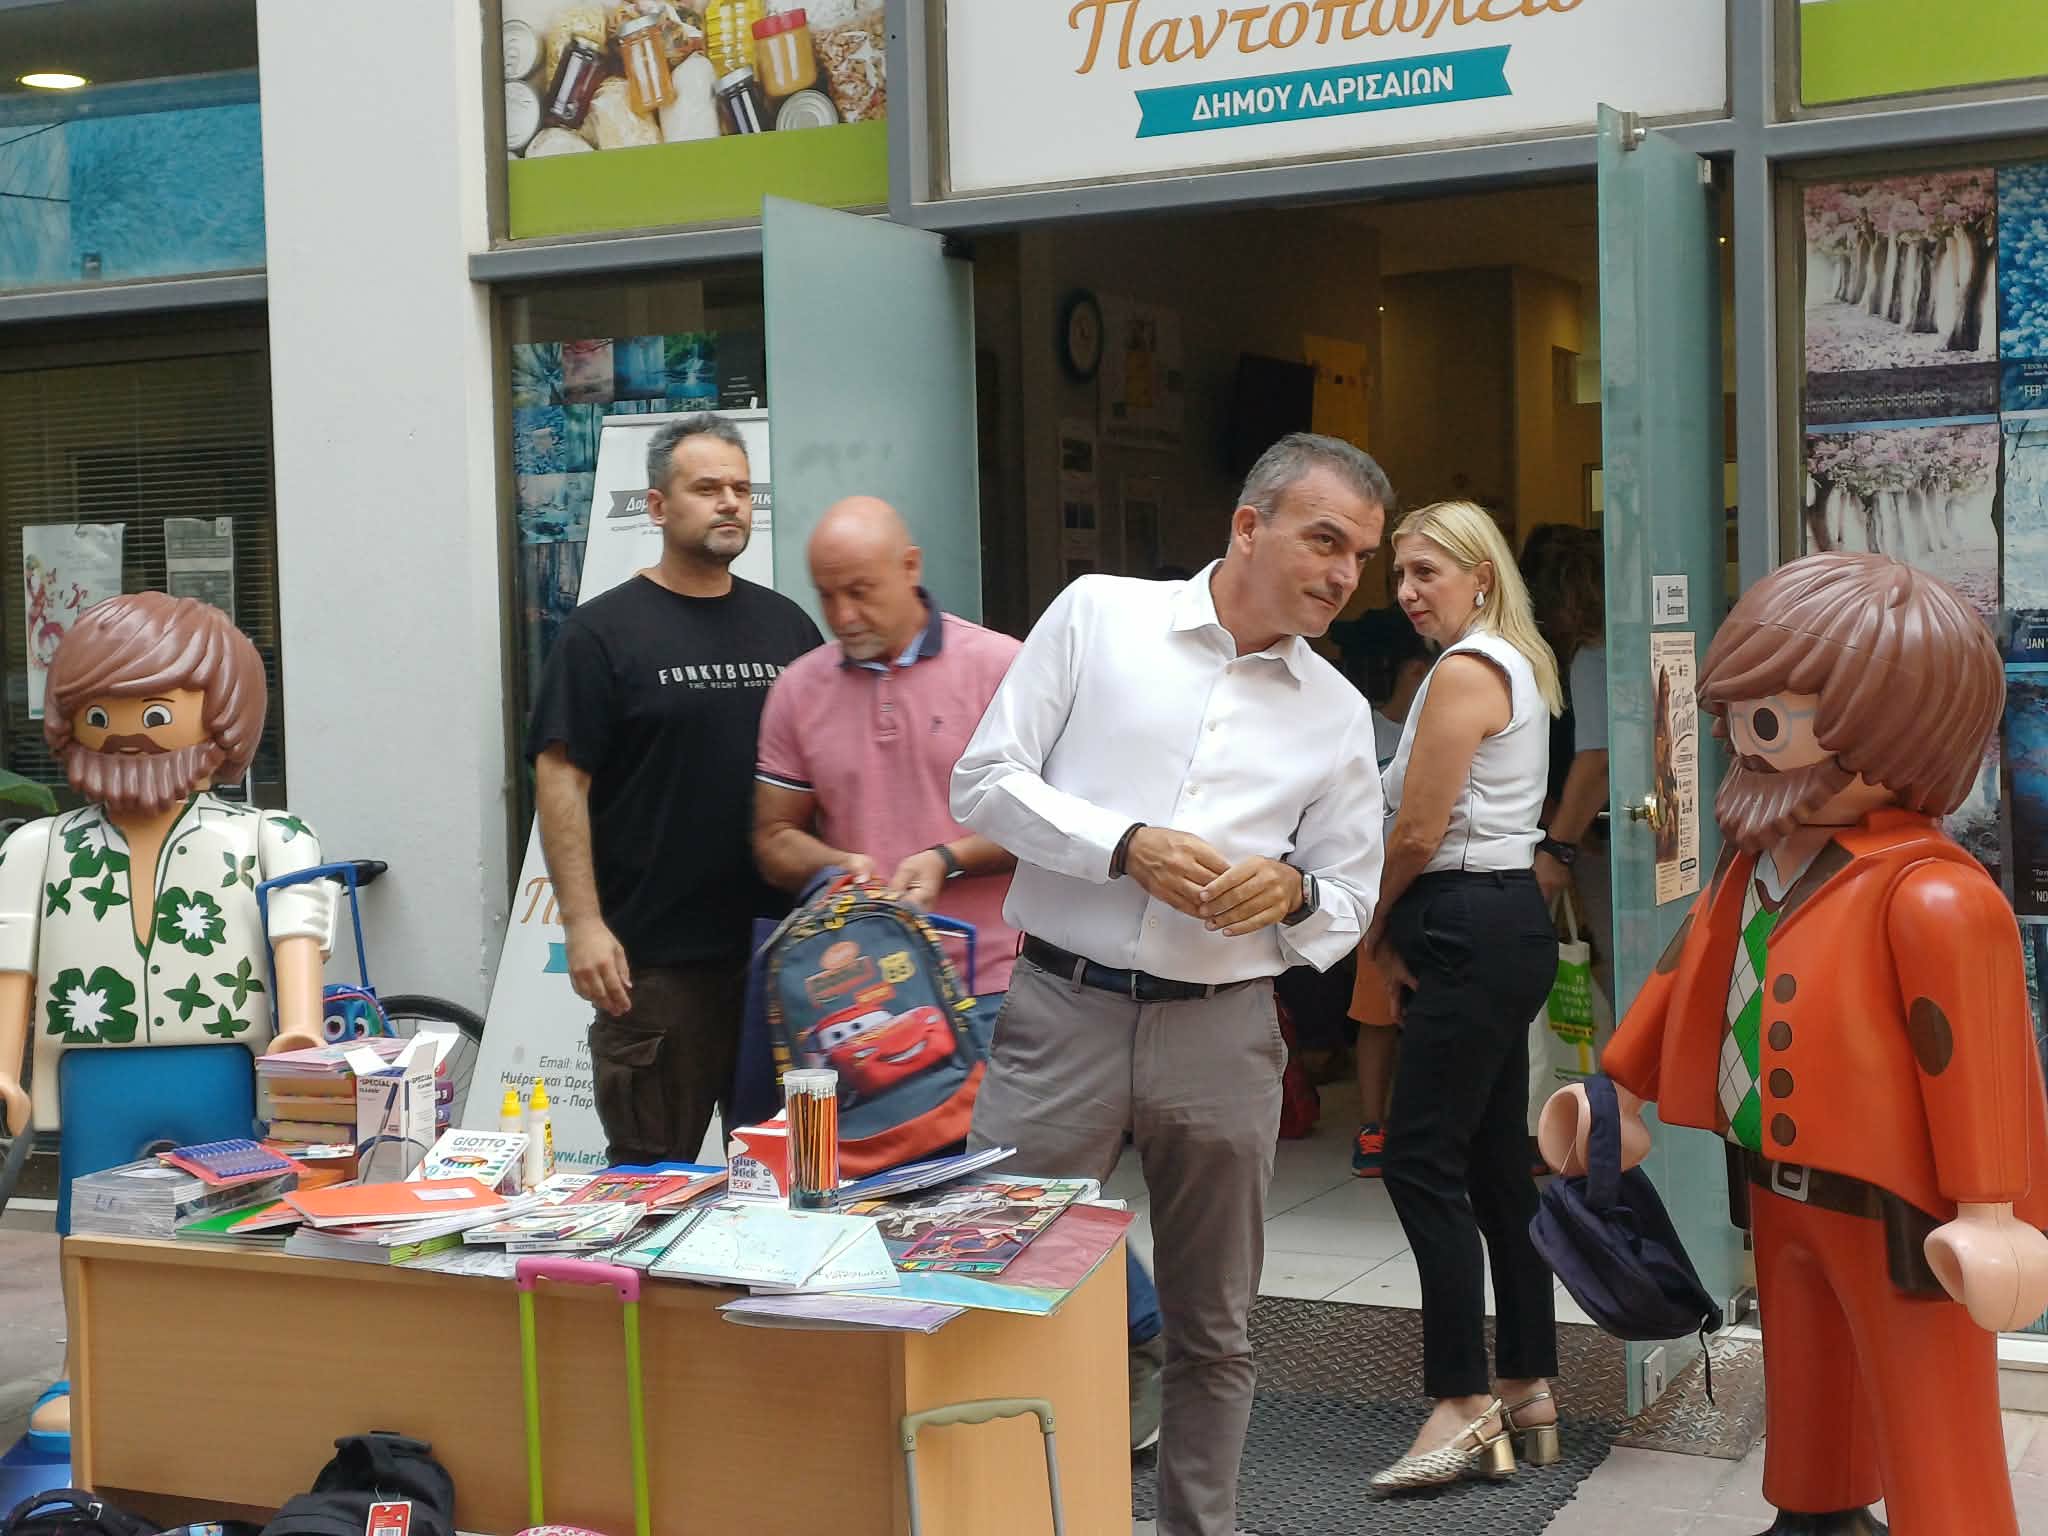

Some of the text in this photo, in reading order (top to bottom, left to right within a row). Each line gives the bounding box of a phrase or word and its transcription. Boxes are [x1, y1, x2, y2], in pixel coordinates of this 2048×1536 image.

[1192, 65, 1454, 121] ΔΗΜΟΥ ΛΑΡΙΣΑΙΩΝ
[539, 1056, 572, 1070] Email:
[544, 1077, 561, 1087] και
[452, 1136, 506, 1148] GIOTTO
